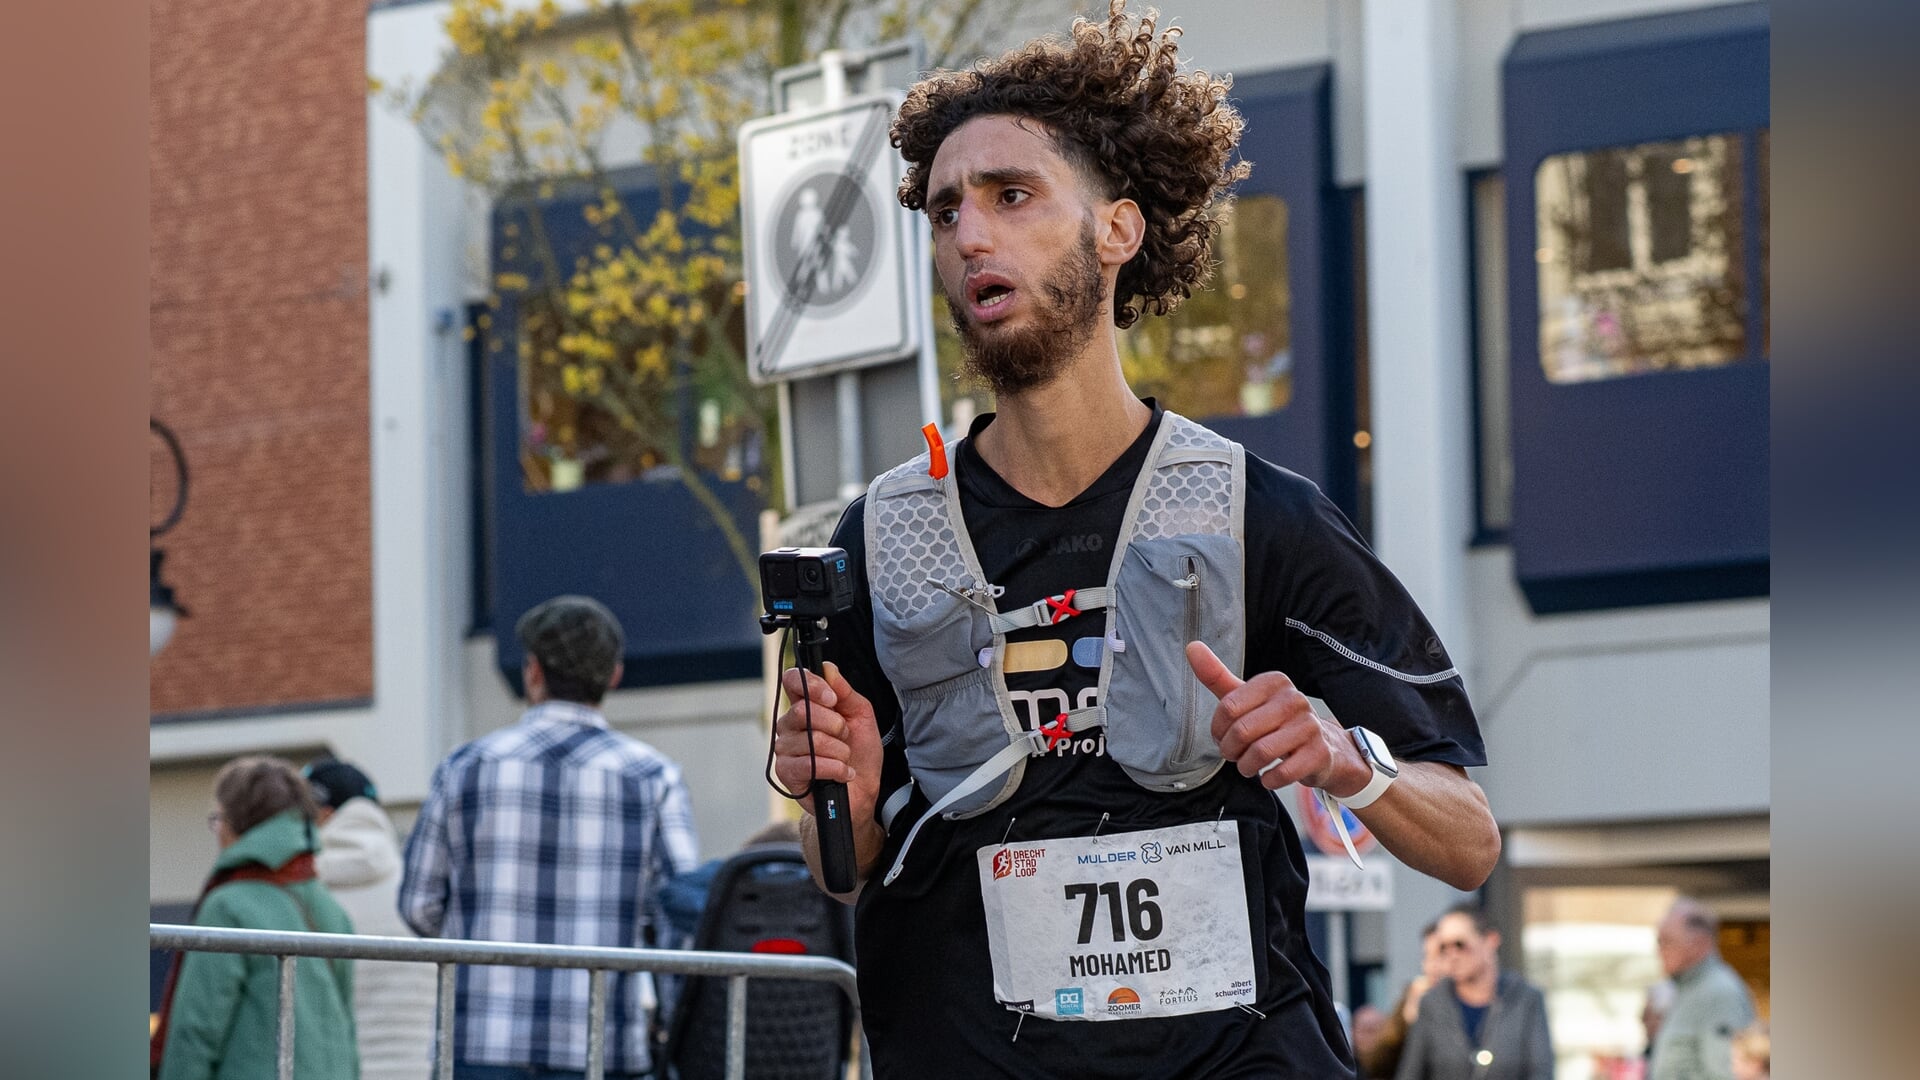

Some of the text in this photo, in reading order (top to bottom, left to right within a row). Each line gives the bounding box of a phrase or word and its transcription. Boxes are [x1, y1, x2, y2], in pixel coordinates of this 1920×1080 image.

[1165, 838, 1227, 856] VAN MILL
[1013, 848, 1046, 860] DRECHT
[1077, 851, 1137, 865] MULDER
[1014, 858, 1037, 868] STAD
[1015, 868, 1038, 878] LOOP
[1064, 878, 1164, 945] 716
[1069, 948, 1172, 978] MOHAMED
[1230, 979, 1252, 988] albert
[1214, 986, 1253, 998] schweitzer
[1159, 994, 1198, 1006] FORTIUS
[1107, 1003, 1141, 1012] ZOOMER
